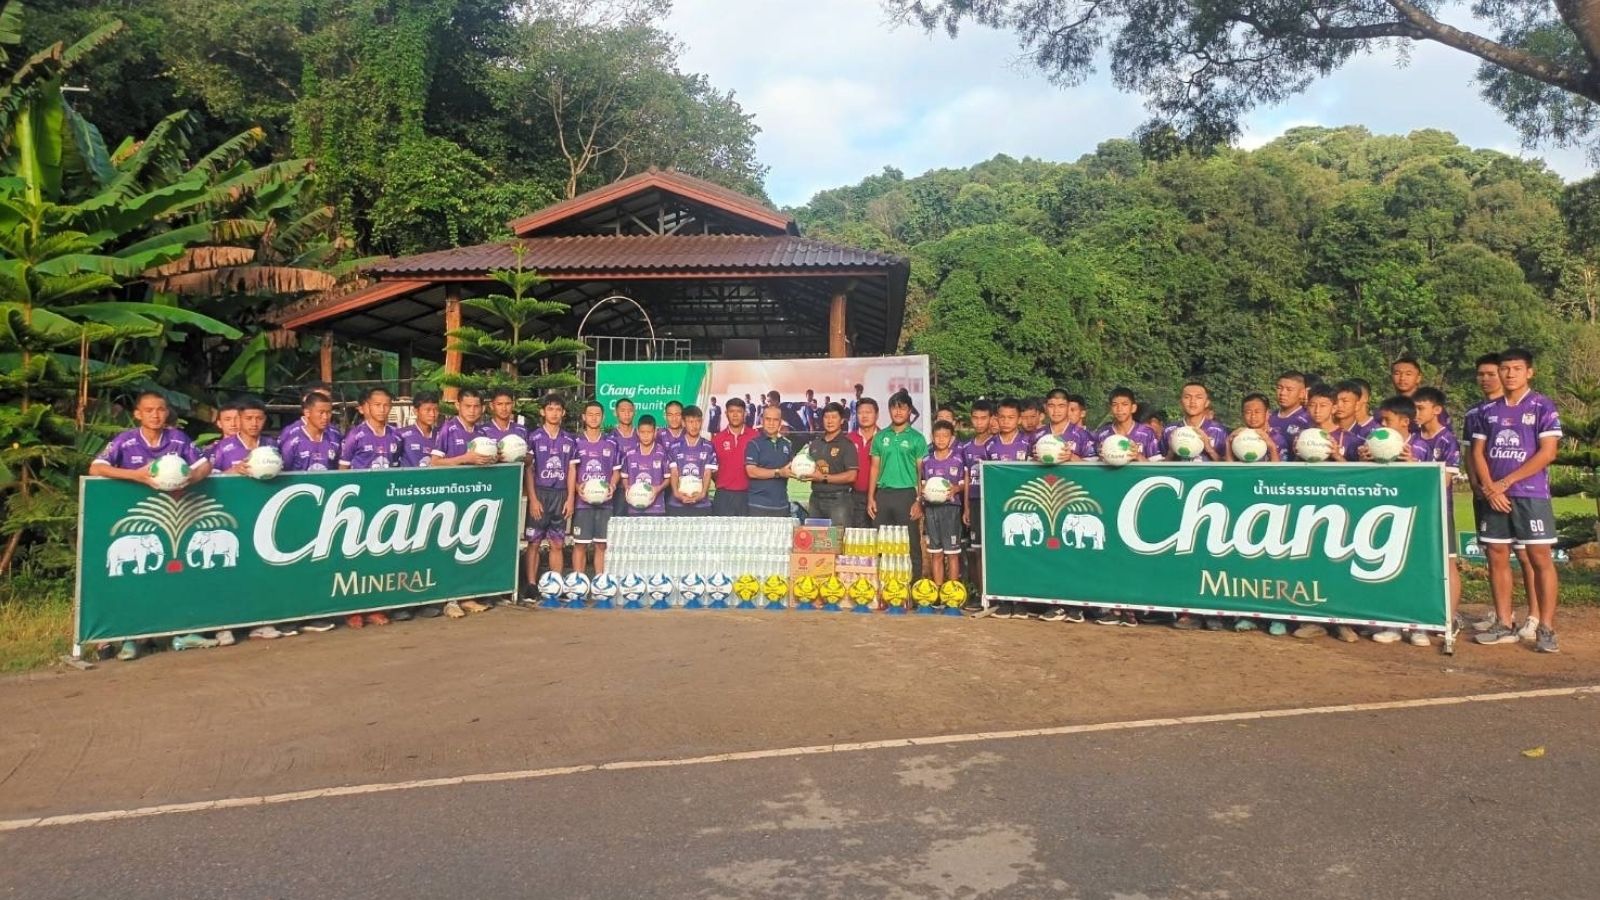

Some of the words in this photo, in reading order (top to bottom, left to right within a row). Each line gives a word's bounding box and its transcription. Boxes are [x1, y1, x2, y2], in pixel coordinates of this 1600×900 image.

[600, 384, 635, 398] Chang
[638, 385, 680, 395] Football
[609, 400, 666, 412] Cmunity
[1489, 446, 1527, 462] Chang
[540, 469, 565, 481] Chang
[386, 481, 493, 497] น้ำแร่ธรรมชาติตราช้าง
[1252, 479, 1399, 498] น้ำแร่ธรรมชาติตราช้าง
[253, 483, 503, 565] Chang
[1116, 476, 1417, 583] Chang
[1530, 519, 1544, 532] 60
